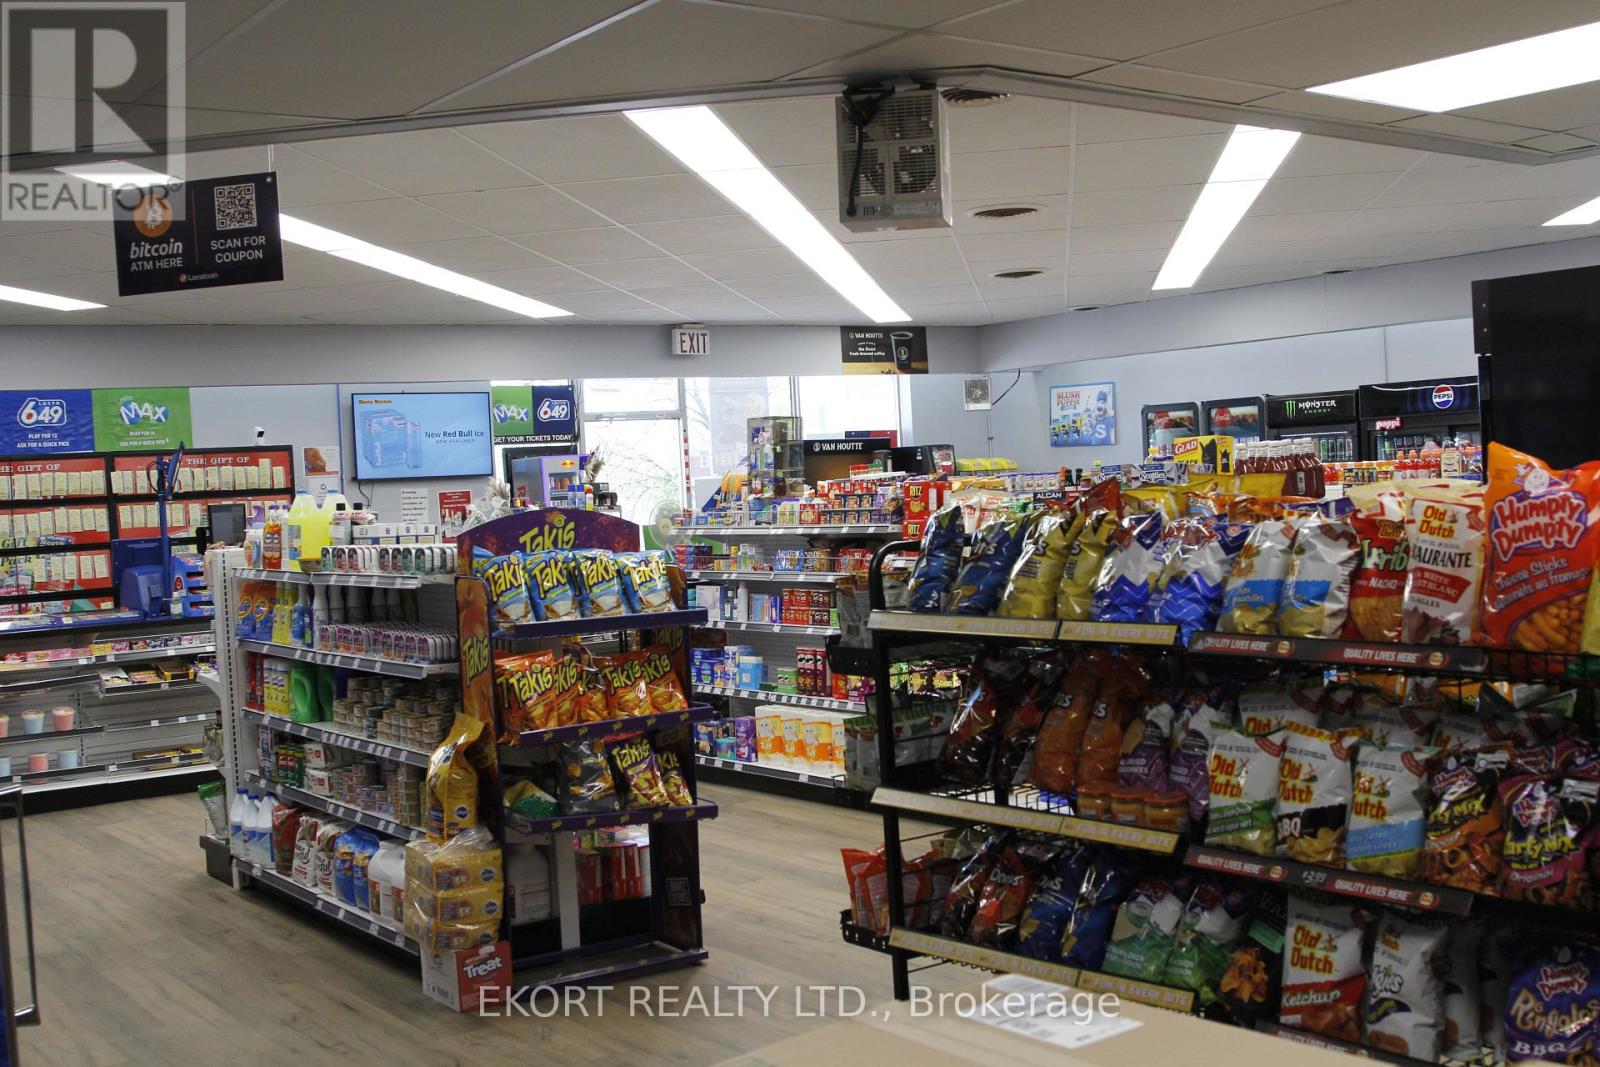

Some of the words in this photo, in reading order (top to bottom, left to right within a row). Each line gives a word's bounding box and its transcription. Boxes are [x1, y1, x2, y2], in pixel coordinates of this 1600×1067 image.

[130, 238, 183, 259] bitcoin
[210, 238, 241, 250] SCAN
[244, 236, 266, 246] FOR
[131, 260, 153, 272] ATM
[155, 257, 183, 269] HERE
[215, 249, 264, 263] COUPON
[679, 332, 708, 354] EXIT
[1056, 391, 1080, 400] SLUSH
[1298, 400, 1336, 409] MONSTER
[120, 402, 167, 424] MAX
[1376, 417, 1400, 430] poppi
[822, 442, 836, 450] VAN
[838, 442, 862, 450] HOUTTE
[1175, 440, 1198, 454] GLAD
[0, 464, 13, 472] HE
[17, 464, 42, 472] GIFT
[1140, 471, 1166, 480] Scotties
[910, 486, 922, 498] RITZ
[1424, 505, 1447, 521] Old
[1494, 492, 1585, 529] Humpty
[519, 514, 576, 552] Takis
[908, 524, 920, 536] RITZ
[1419, 520, 1455, 538] Dutch
[1492, 519, 1584, 561] Dumpty
[485, 555, 522, 602] Taki
[1076, 626, 1097, 637] FUN
[1111, 627, 1141, 638] EVERY
[1146, 628, 1170, 640] BITE
[1230, 640, 1249, 650] LIVES
[463, 630, 490, 687] Takis
[1344, 648, 1374, 660] QUALITY
[1374, 650, 1396, 662] LIVES
[552, 653, 578, 695] akis
[604, 660, 642, 695] Takis
[641, 654, 671, 684] akis
[508, 662, 552, 707] Takis
[612, 739, 650, 772] Takis
[1212, 754, 1235, 776] Old
[1282, 758, 1302, 780] Old
[1196, 854, 1222, 868] QUALITY
[1224, 858, 1242, 871] LIVES
[1334, 879, 1363, 894] QUALITY
[1364, 884, 1386, 898] LIVES
[1294, 926, 1322, 948] Old
[463, 956, 502, 980] Treat
[1291, 947, 1334, 974] Dutch
[1129, 986, 1160, 1000] EVERY
[1164, 992, 1188, 1006] BITE
[1281, 988, 1342, 1008] Ketchup
[1513, 1040, 1567, 1056] BBQ
